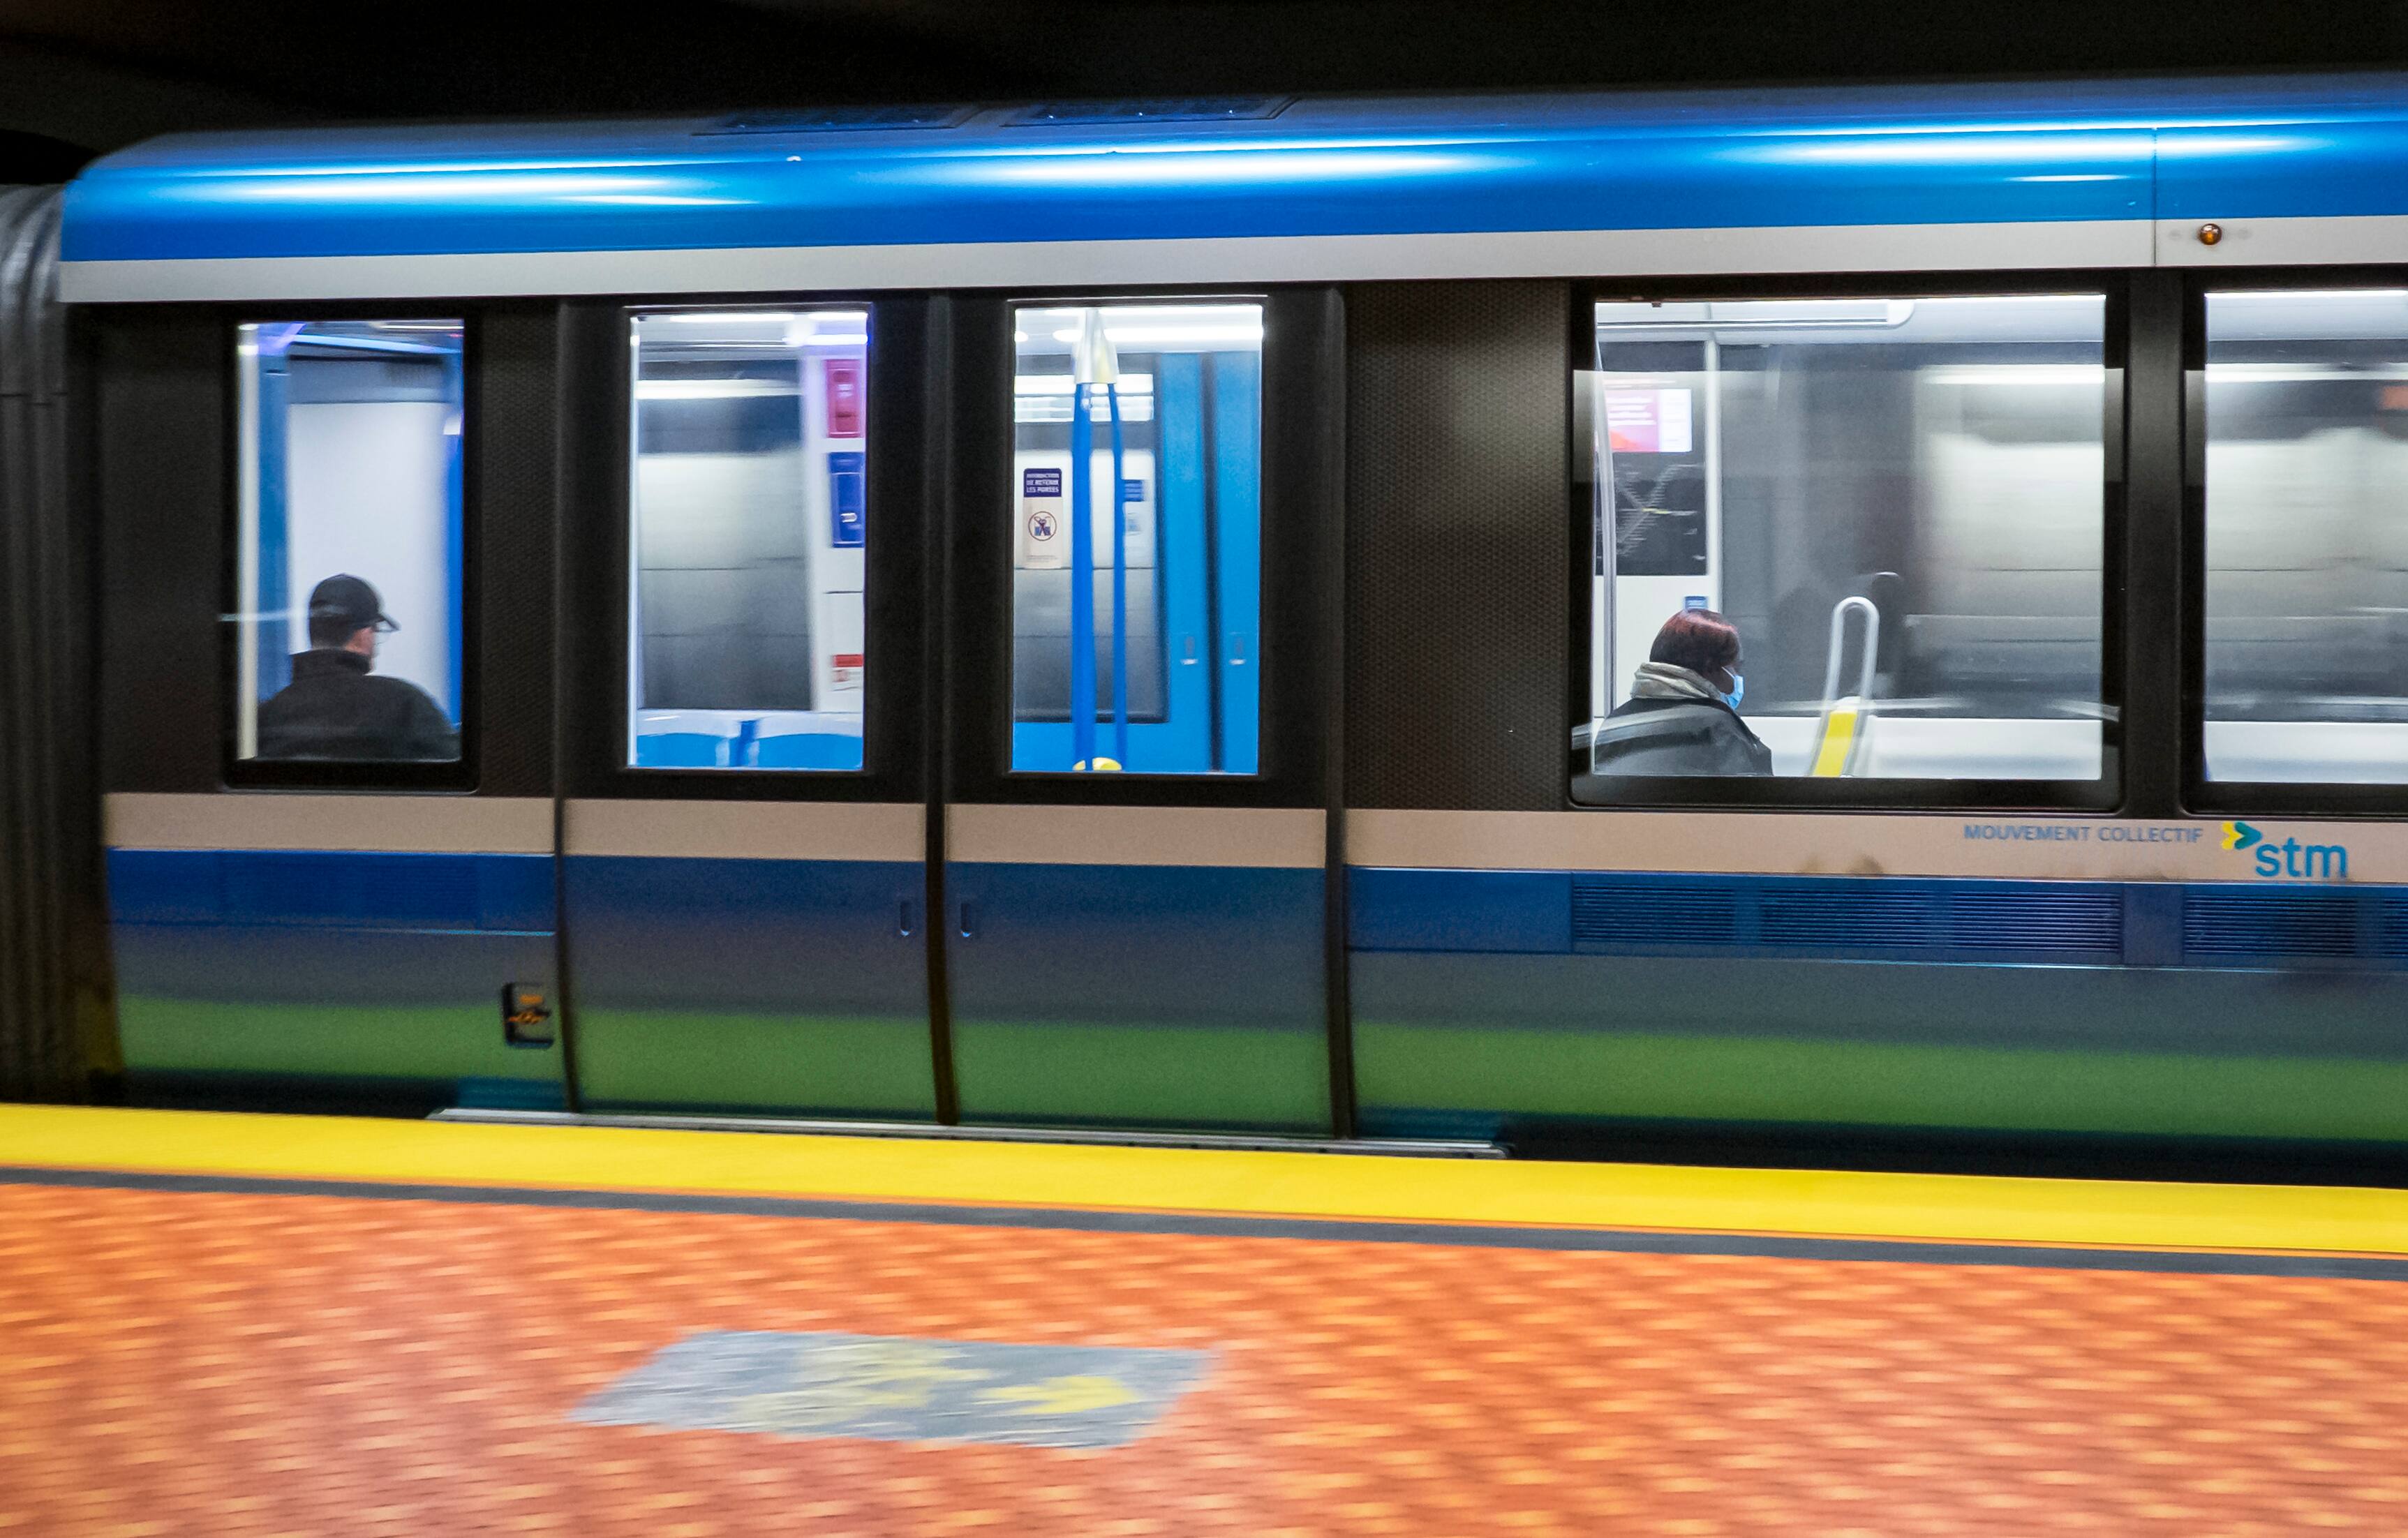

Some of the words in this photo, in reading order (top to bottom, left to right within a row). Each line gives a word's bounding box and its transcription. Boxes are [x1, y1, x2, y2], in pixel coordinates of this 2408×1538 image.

[1963, 825, 2090, 842] MOUVEMENT
[2098, 826, 2203, 843] COLLECTIF
[2255, 837, 2347, 878] stm
